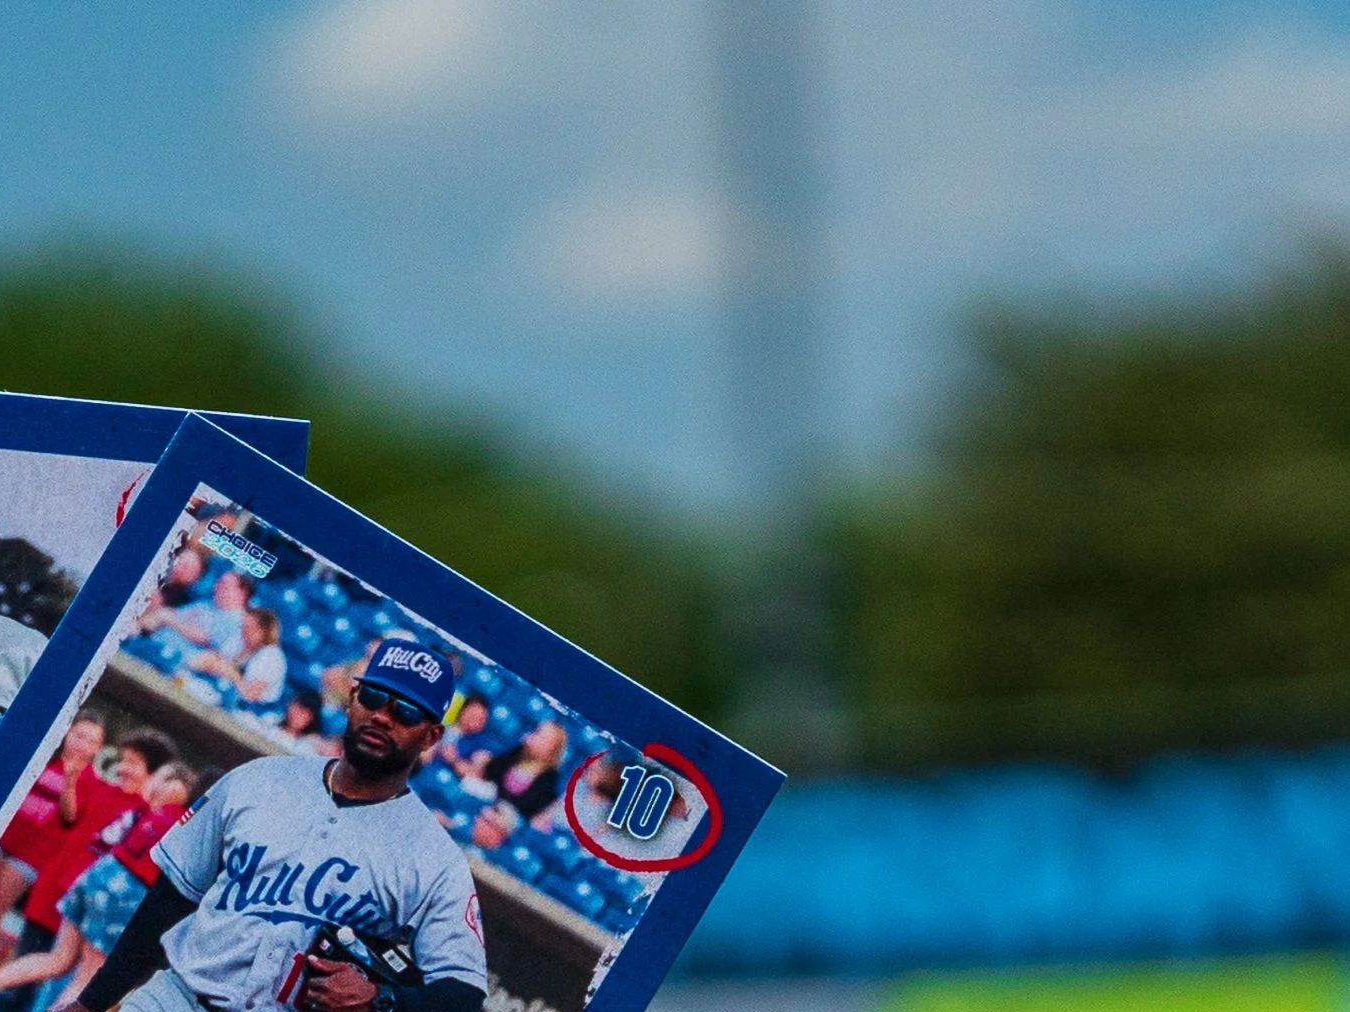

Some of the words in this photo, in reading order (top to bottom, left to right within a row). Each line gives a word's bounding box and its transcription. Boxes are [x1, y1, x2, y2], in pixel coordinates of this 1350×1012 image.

[198, 531, 271, 579] 2026
[206, 519, 278, 569] CHOICE
[378, 646, 415, 671] Hill
[409, 651, 443, 684] City
[606, 765, 675, 840] 10
[214, 842, 305, 913] Hill
